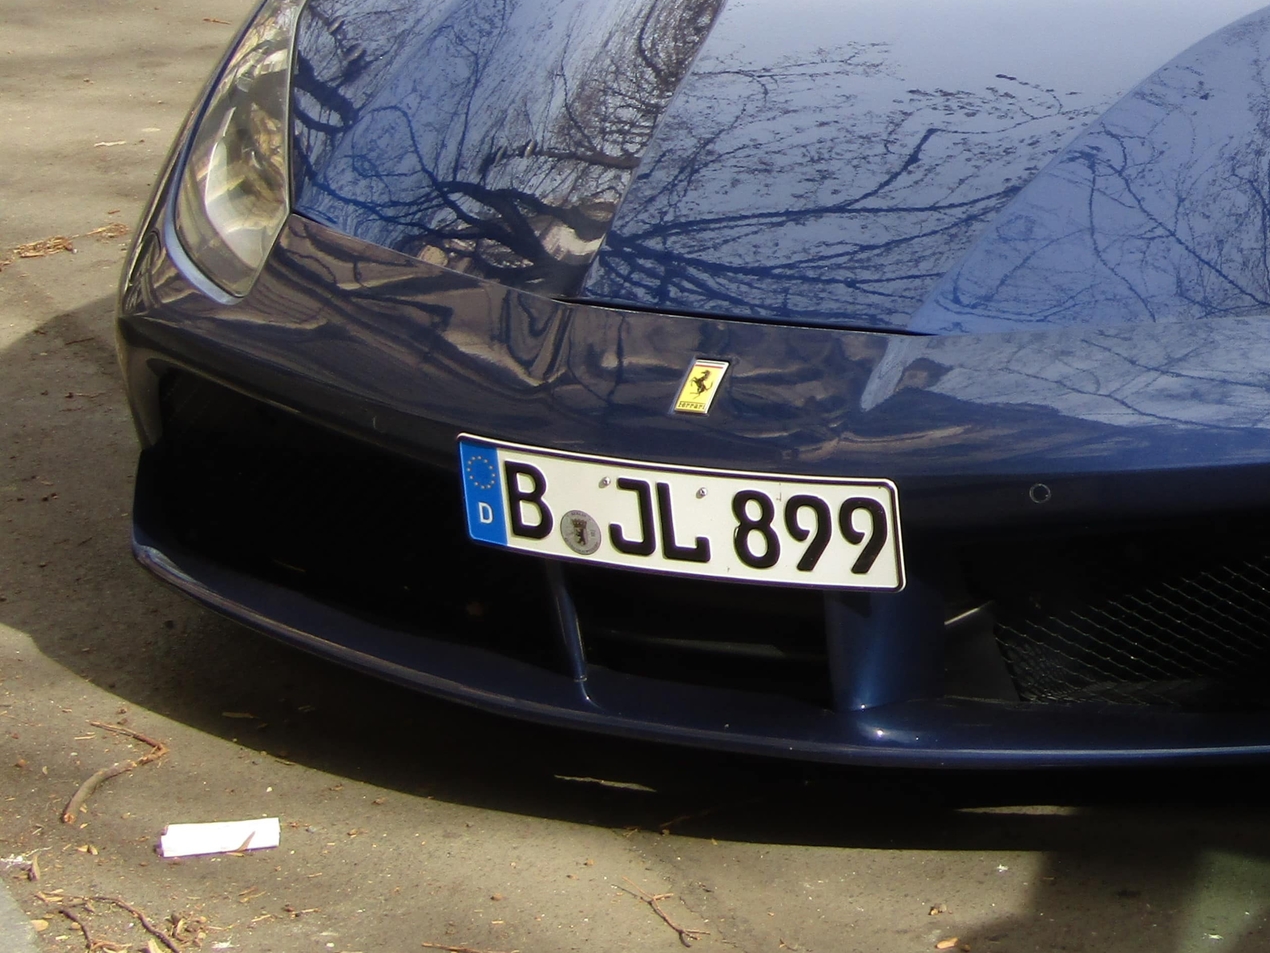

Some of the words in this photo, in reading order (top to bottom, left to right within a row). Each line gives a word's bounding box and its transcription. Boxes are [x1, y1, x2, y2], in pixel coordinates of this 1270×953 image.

[678, 401, 706, 410] Ferrari
[478, 502, 494, 523] D
[504, 460, 554, 539] B
[609, 477, 711, 563] JL
[732, 489, 888, 574] 899
